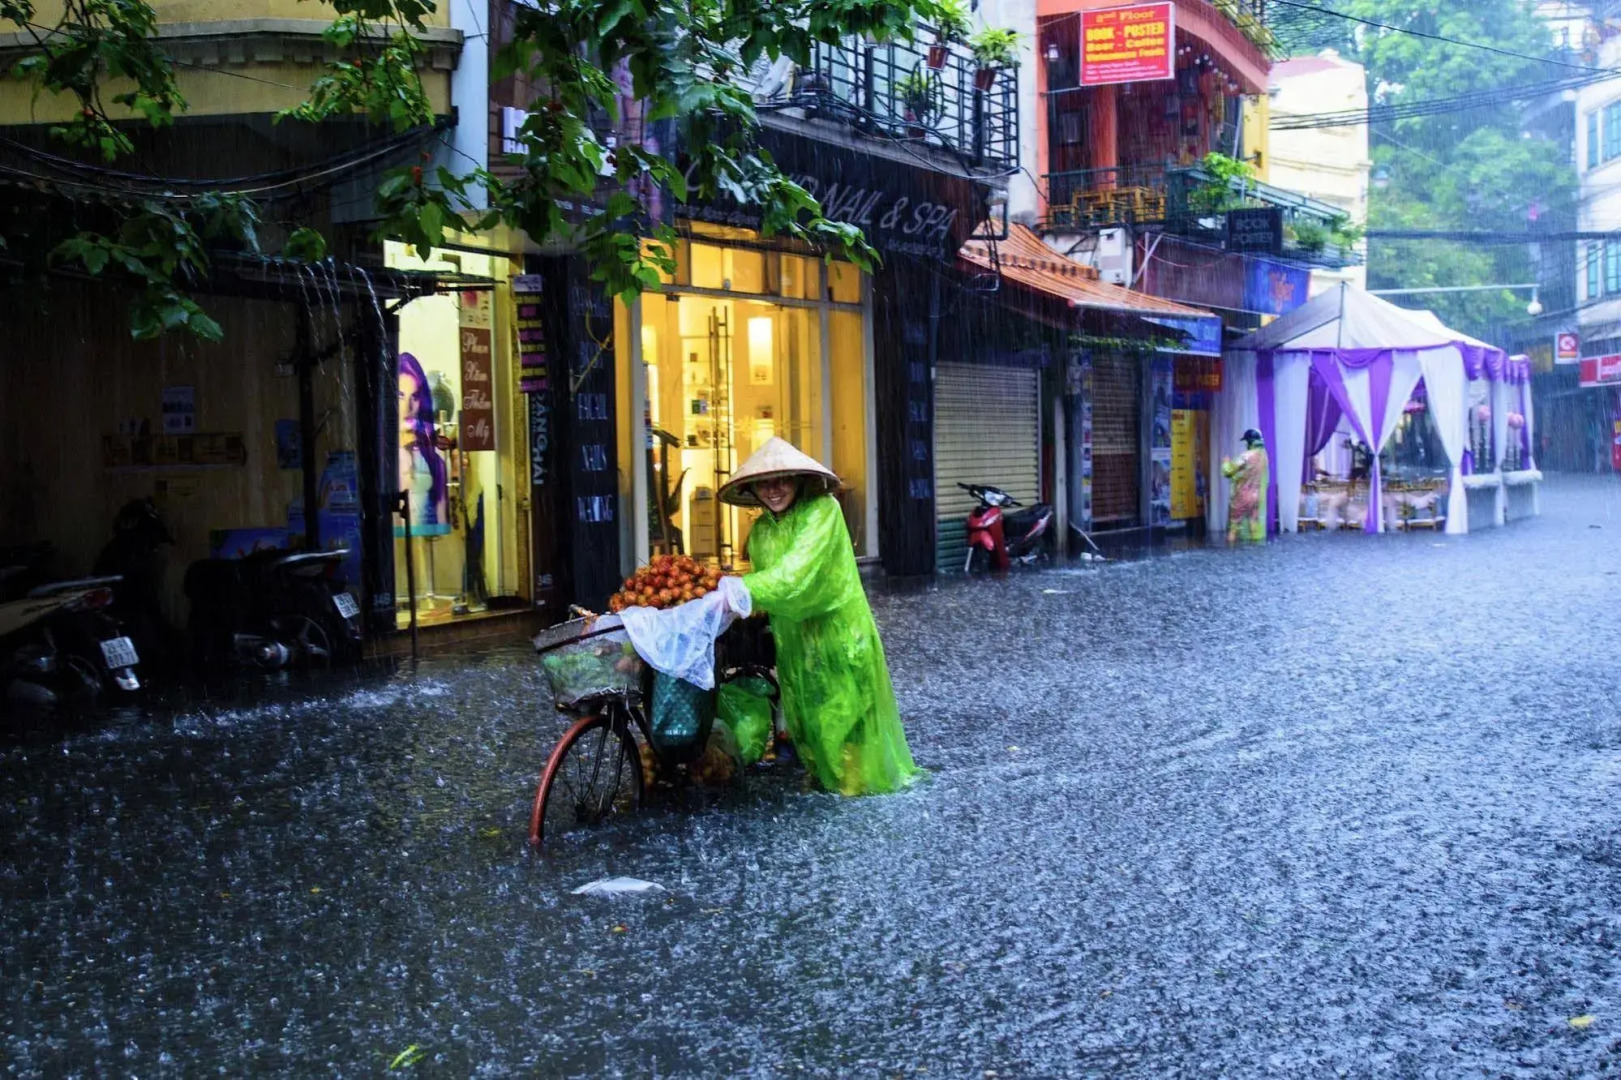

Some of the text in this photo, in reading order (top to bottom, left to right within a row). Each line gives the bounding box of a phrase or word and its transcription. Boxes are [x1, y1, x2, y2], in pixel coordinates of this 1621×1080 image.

[1124, 21, 1165, 38] POSTER
[820, 181, 884, 225] NAIL
[880, 196, 909, 230] &
[902, 200, 960, 240] SPA
[1236, 217, 1270, 230] BOOK
[1231, 231, 1274, 244] POSTER
